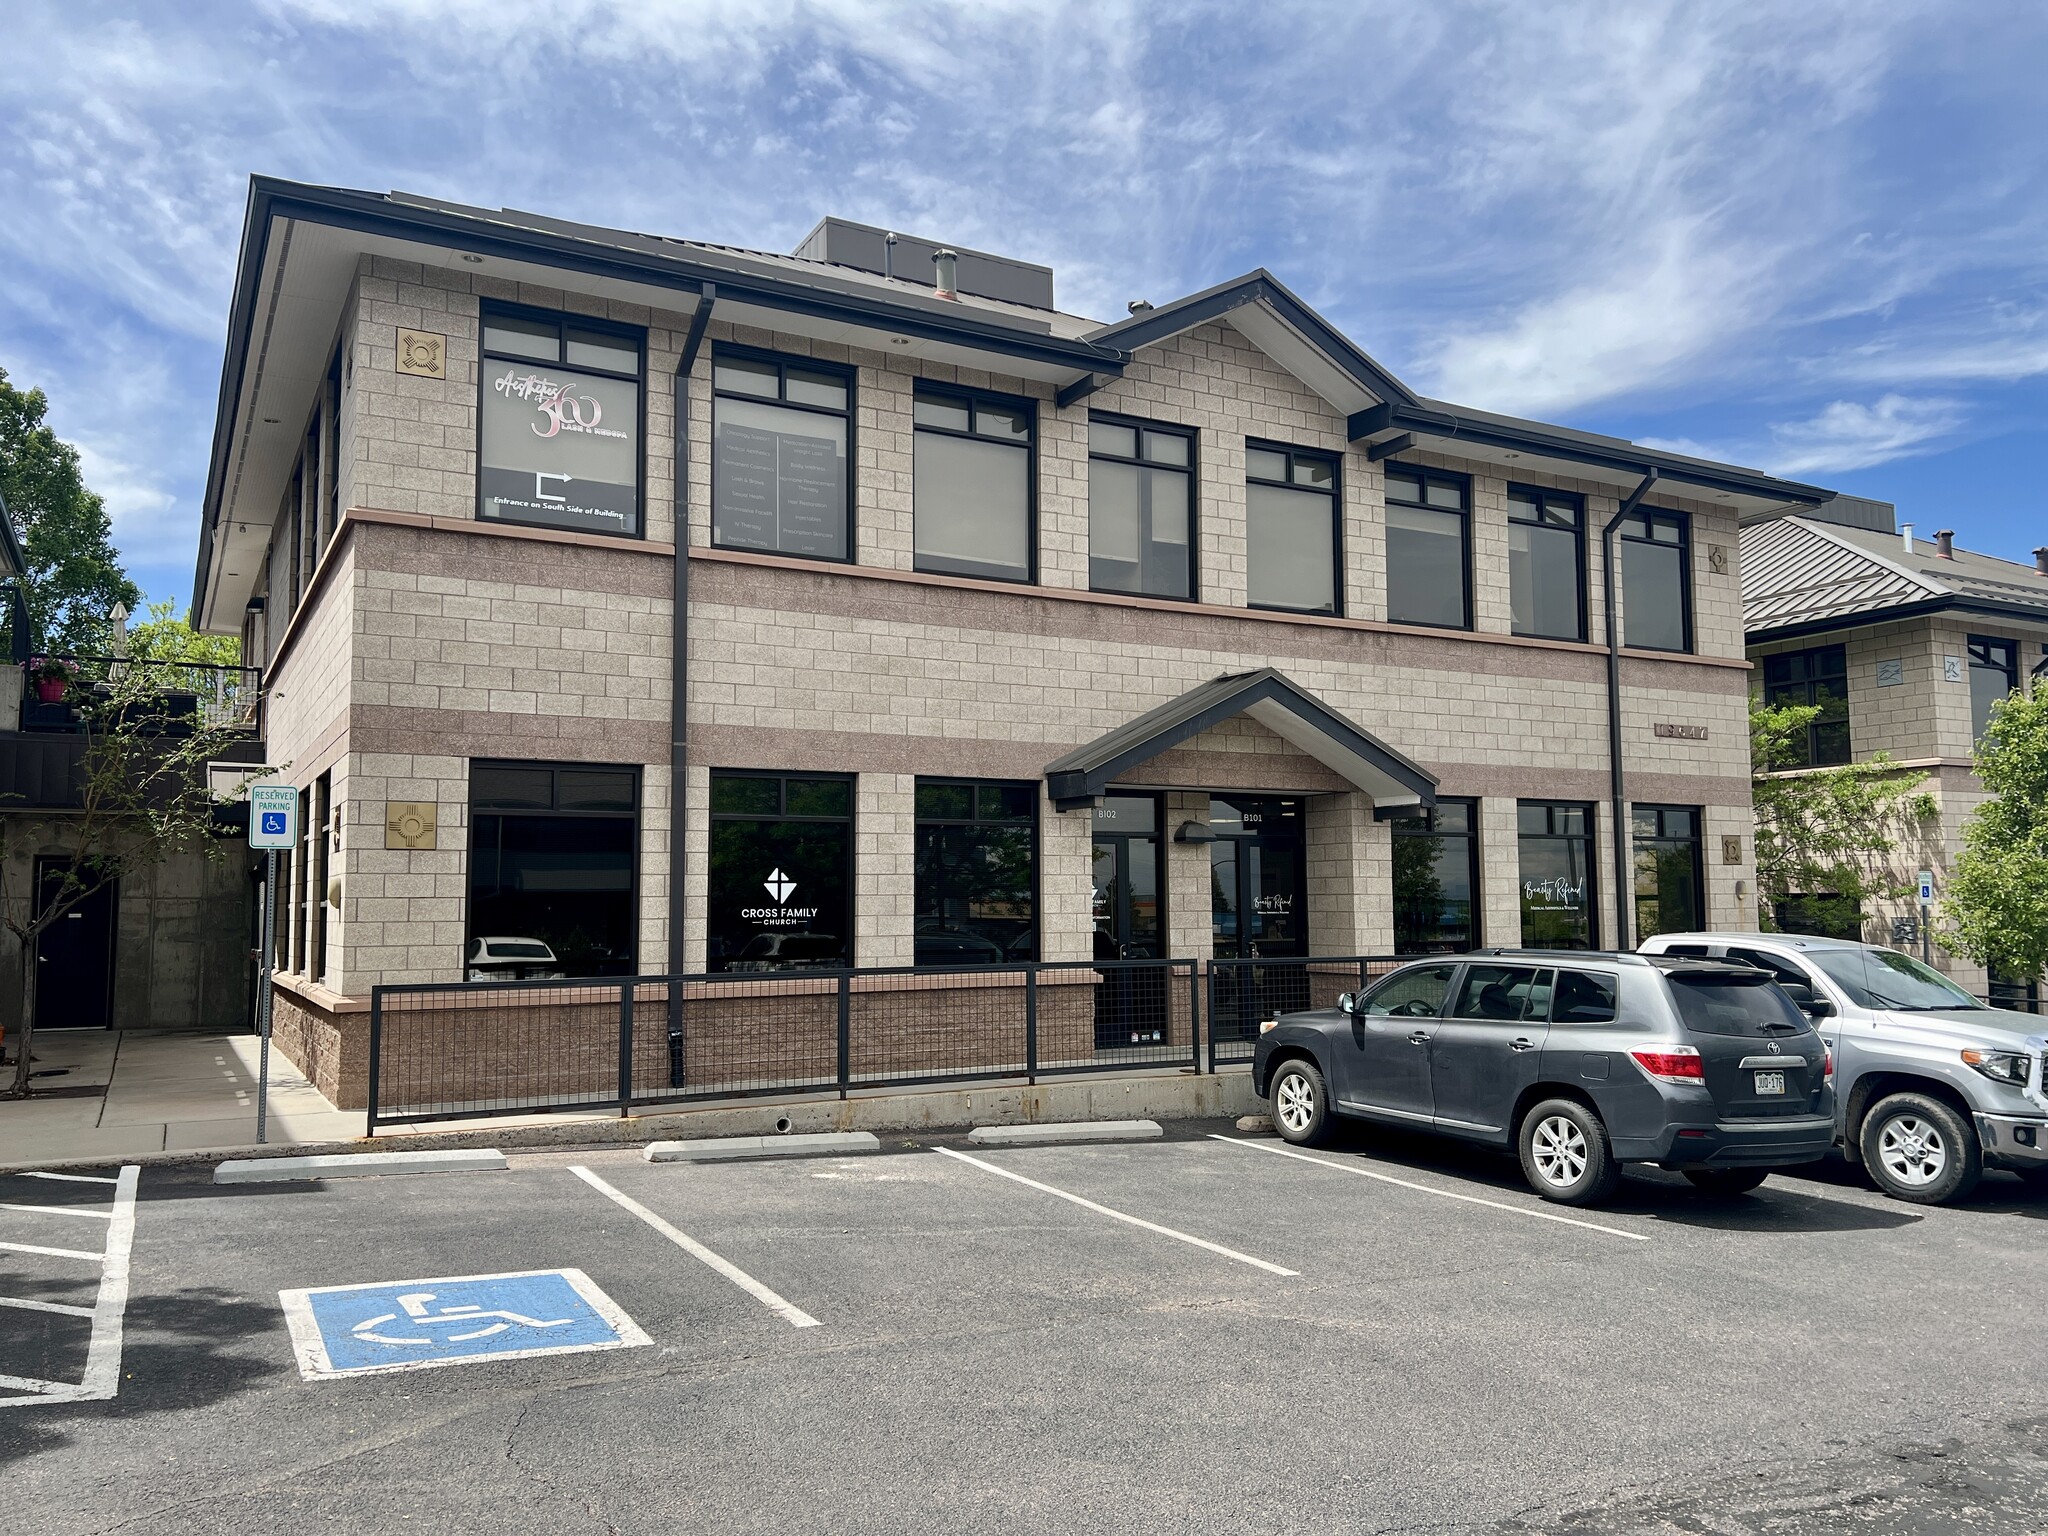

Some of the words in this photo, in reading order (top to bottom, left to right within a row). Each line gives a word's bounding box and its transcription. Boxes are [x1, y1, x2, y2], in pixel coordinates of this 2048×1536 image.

[495, 370, 558, 402] Aesthetics
[531, 383, 601, 437] 360
[494, 497, 529, 508] Entrance
[542, 502, 565, 512] South
[566, 505, 583, 513] Side
[594, 509, 624, 519] Building
[255, 791, 295, 800] RESERVED
[259, 802, 291, 811] PARKING
[1098, 810, 1116, 819] B102
[1243, 813, 1262, 822] B101
[1524, 879, 1554, 902] Beauty
[1554, 876, 1583, 905] Refined
[741, 908, 778, 918] CROSS
[780, 908, 818, 917] FAMILY
